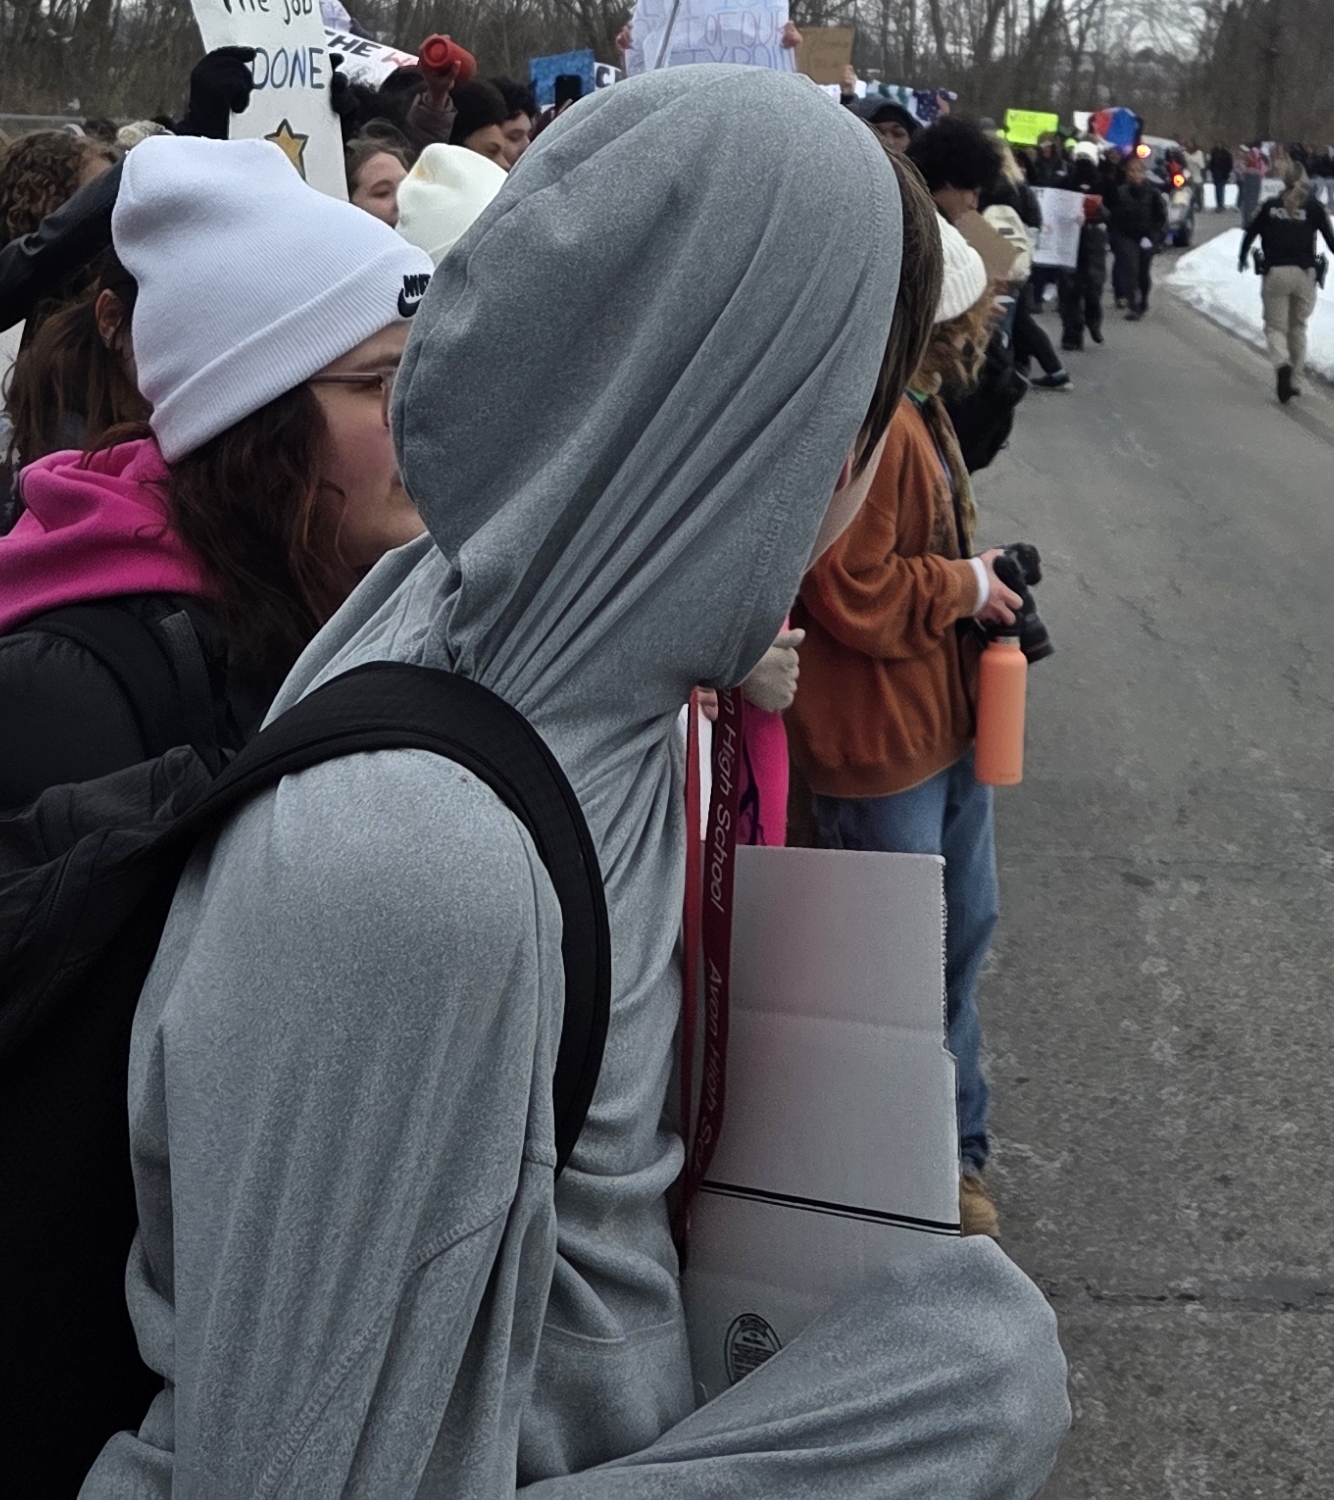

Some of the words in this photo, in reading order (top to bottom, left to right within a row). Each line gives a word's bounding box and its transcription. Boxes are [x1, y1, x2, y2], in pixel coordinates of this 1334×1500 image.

[252, 44, 325, 90] DONE
[717, 723, 737, 797] High
[710, 803, 732, 913] School
